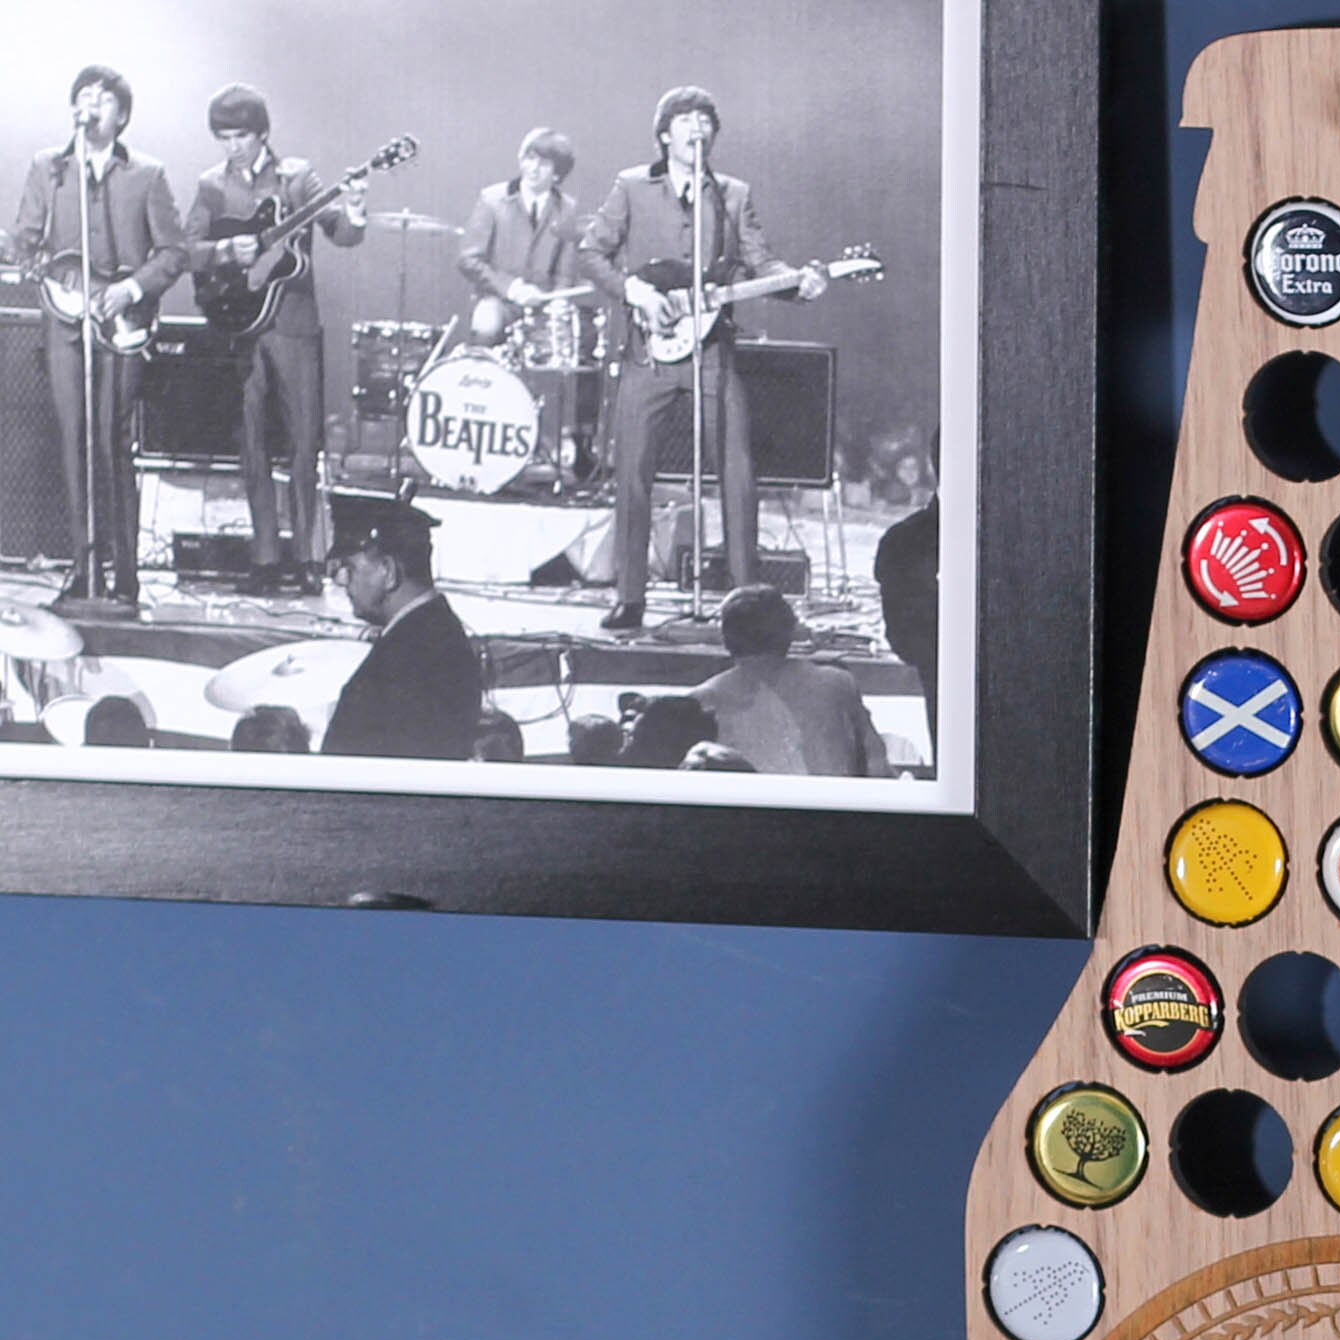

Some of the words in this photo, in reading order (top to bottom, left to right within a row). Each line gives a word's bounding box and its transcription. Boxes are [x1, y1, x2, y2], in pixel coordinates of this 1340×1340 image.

[1281, 273, 1334, 295] Extra
[416, 390, 532, 466] BEATLES
[1130, 990, 1188, 1004] PREMIUM
[1113, 1001, 1210, 1032] KOPPARBERG
